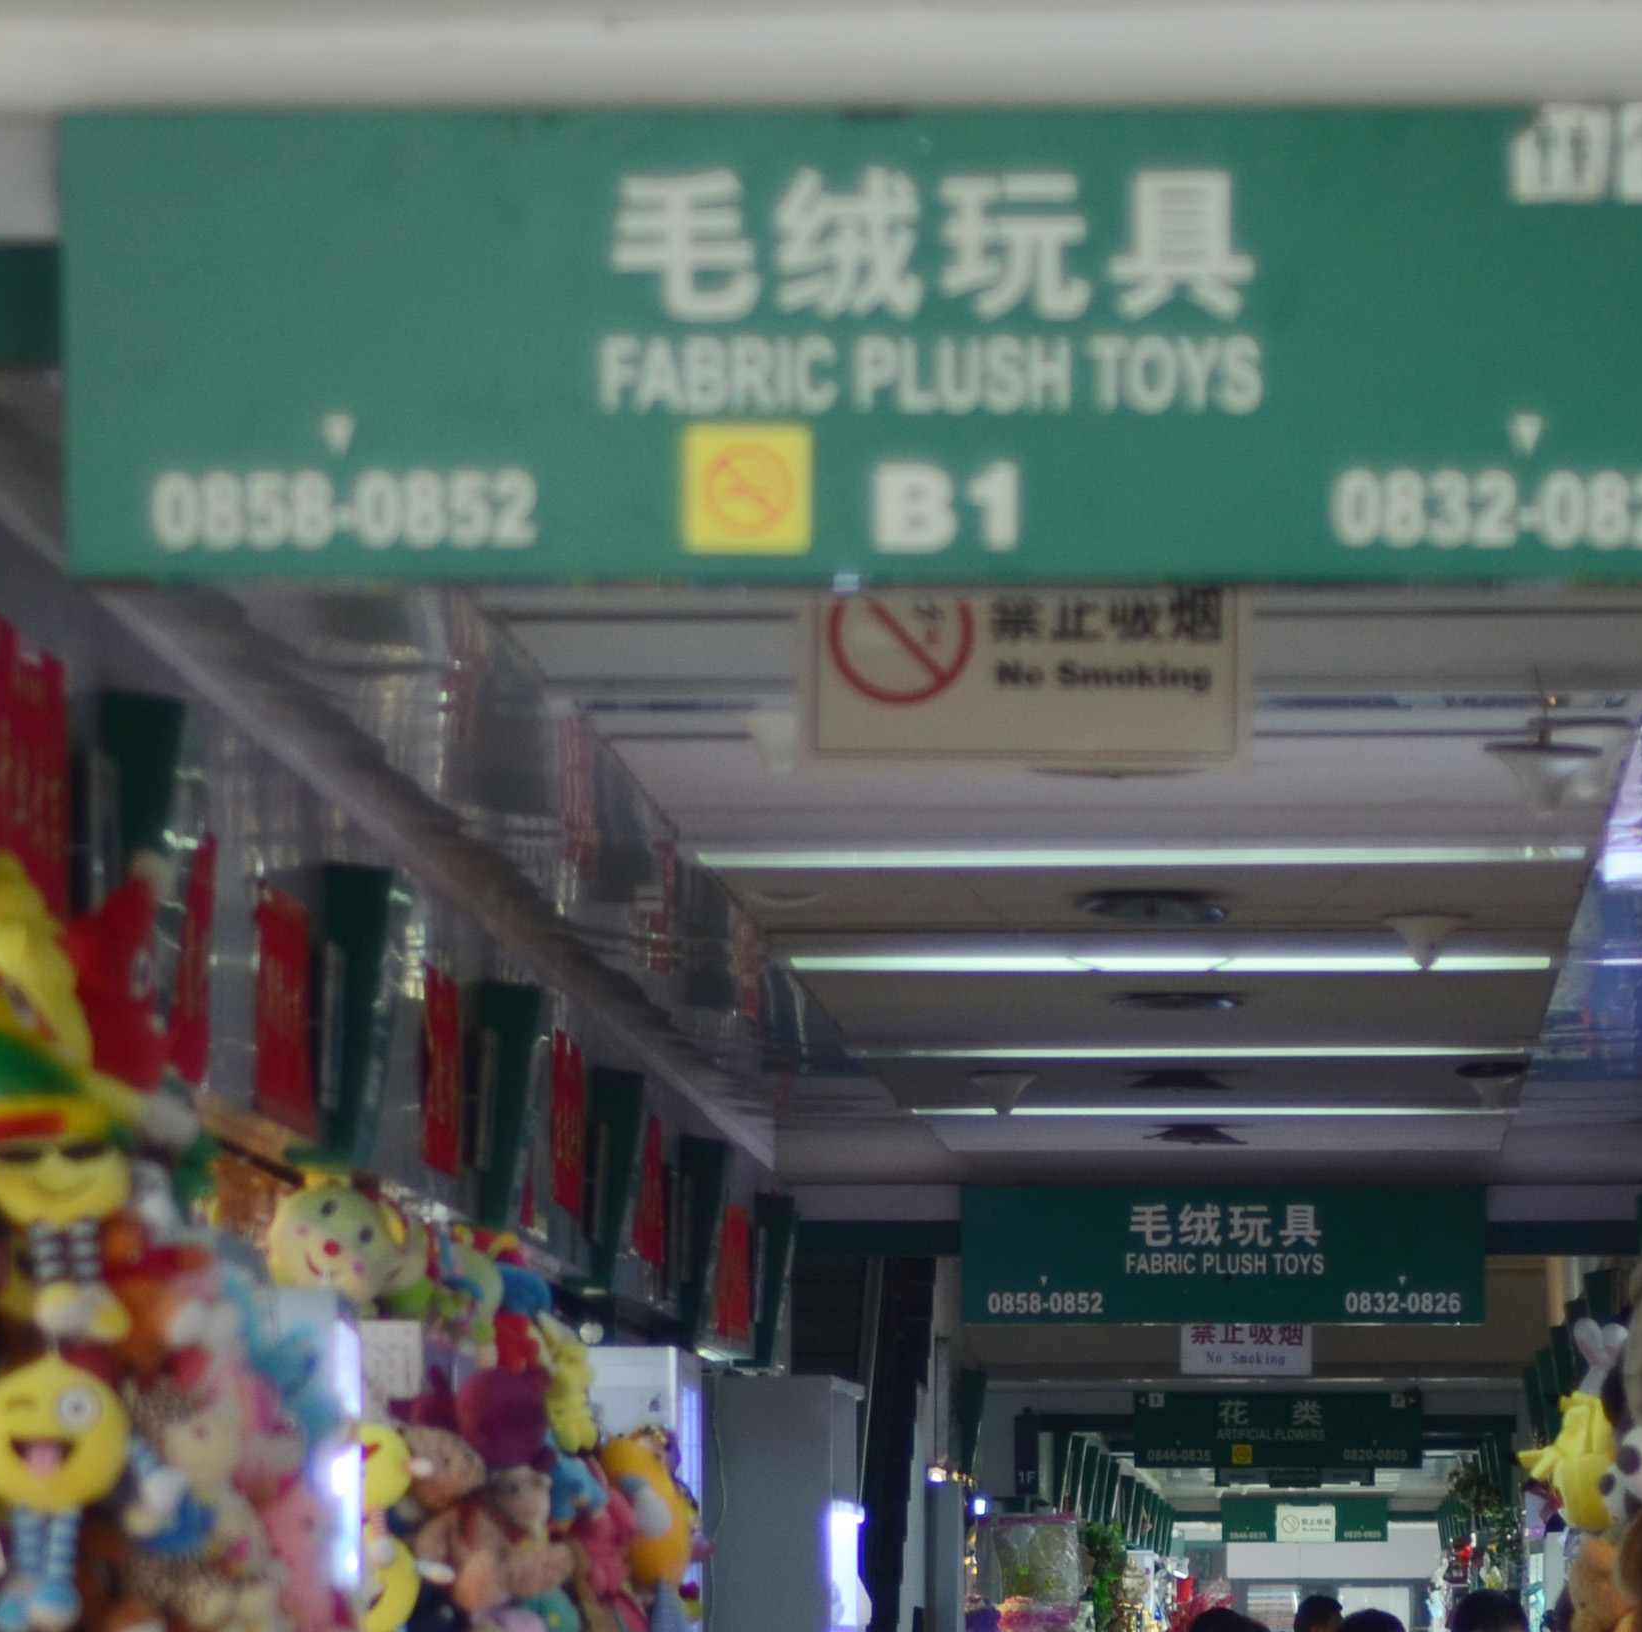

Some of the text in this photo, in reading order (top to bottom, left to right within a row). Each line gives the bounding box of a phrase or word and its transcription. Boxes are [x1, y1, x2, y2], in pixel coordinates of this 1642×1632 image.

[612, 168, 1255, 320] 毛绒玩具
[600, 335, 1263, 413] FABRIC PLUSH TOYS
[153, 470, 539, 549] 0858-0852
[873, 461, 1020, 553] B1
[997, 660, 1213, 694] No Smoking
[1129, 1204, 1323, 1248] 毛绒玩具
[1126, 1253, 1324, 1275] FABRIC PLUSH TOYS
[988, 1292, 1104, 1315] 0858-0852
[1345, 1292, 1461, 1314] 0832-0826
[1206, 1351, 1286, 1366] No Smoking
[1217, 1428, 1325, 1441] ARTIFICIAL FLOWERS
[1018, 1471, 1036, 1485] 1F
